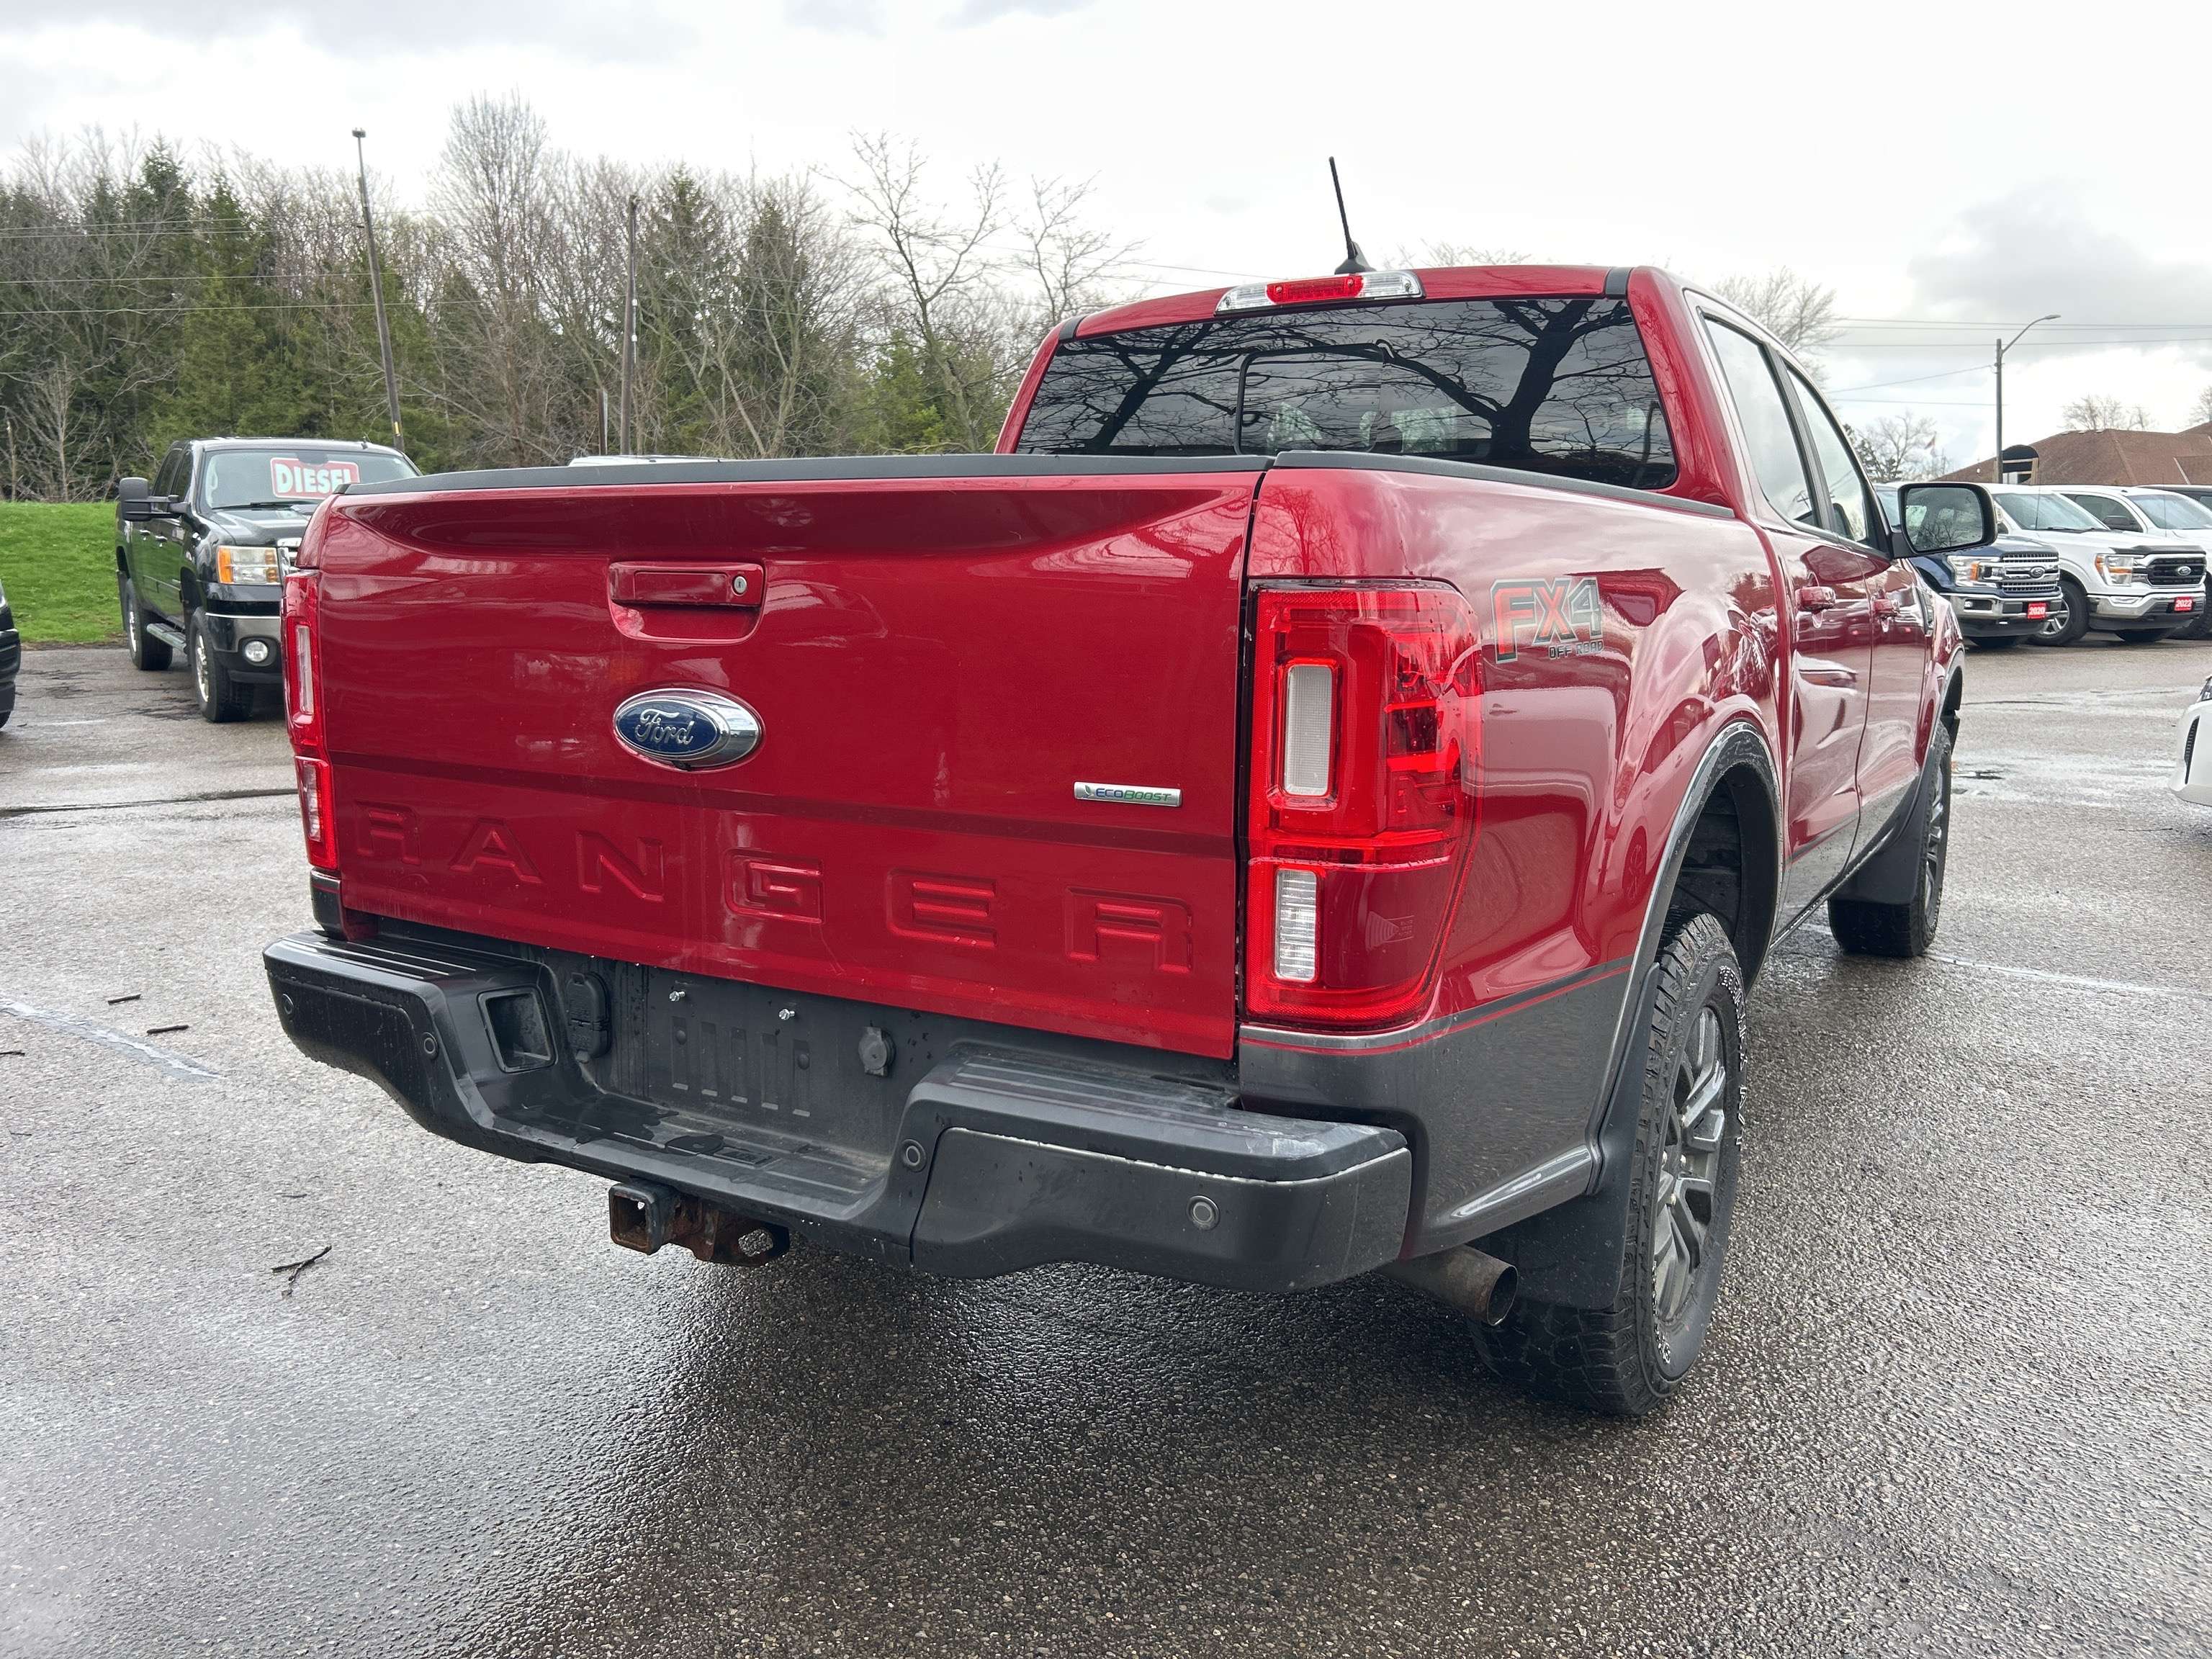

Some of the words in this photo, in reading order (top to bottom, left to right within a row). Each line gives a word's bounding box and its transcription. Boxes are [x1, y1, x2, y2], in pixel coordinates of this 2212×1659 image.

[1491, 577, 1603, 664] FX4
[1549, 644, 1573, 660] OFF
[1575, 639, 1605, 657] ROAD
[634, 708, 695, 745] Ford
[354, 799, 1192, 974] RANGER
